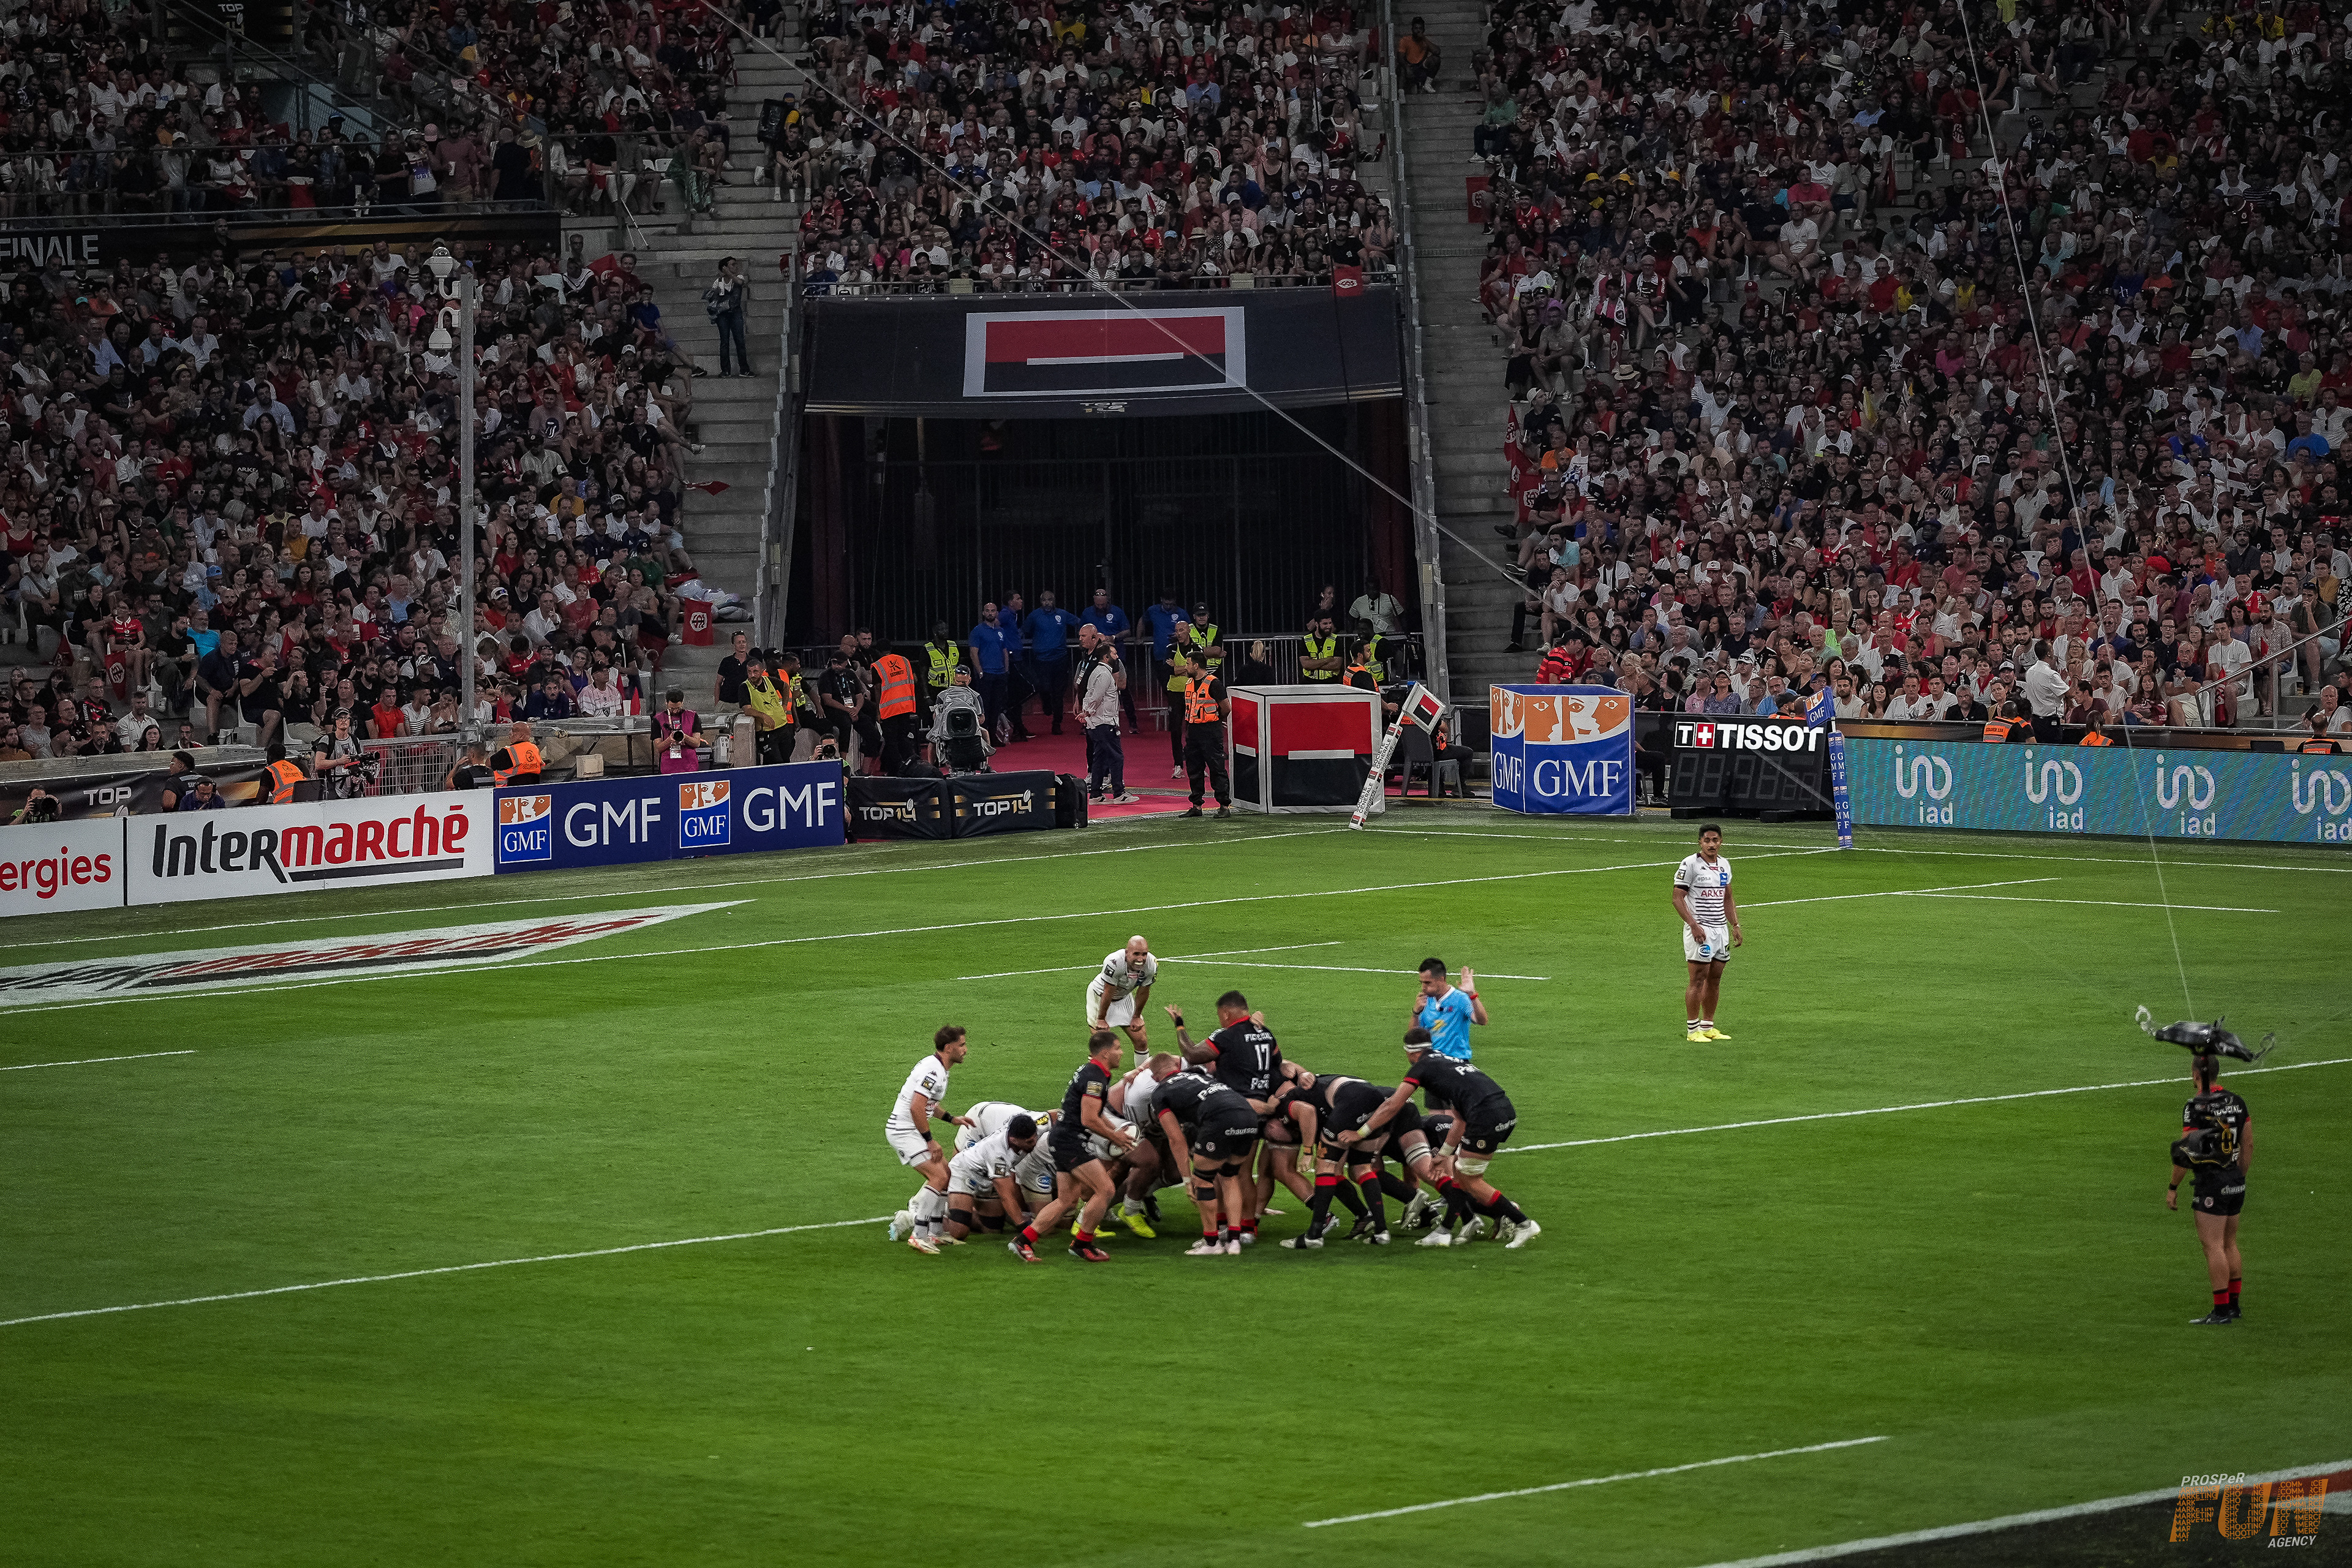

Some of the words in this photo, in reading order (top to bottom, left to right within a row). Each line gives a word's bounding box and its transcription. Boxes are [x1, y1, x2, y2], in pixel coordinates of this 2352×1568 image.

[217, 4, 244, 12] TOP
[1810, 706, 1825, 722] GMF
[1716, 723, 1825, 752] TISSOT
[1493, 751, 1523, 794] GMF
[1533, 760, 1623, 797] GMF
[83, 786, 132, 807] TOP
[743, 782, 836, 832] GMF
[565, 797, 661, 848] GMF
[1918, 801, 1954, 824] iad
[2049, 806, 2083, 829] iad
[2180, 811, 2215, 835] iad
[685, 815, 726, 837] GMF
[2317, 816, 2351, 840] iad
[504, 829, 547, 853] GMF
[0, 847, 111, 899] ergies
[1254, 1043, 1270, 1071] 17
